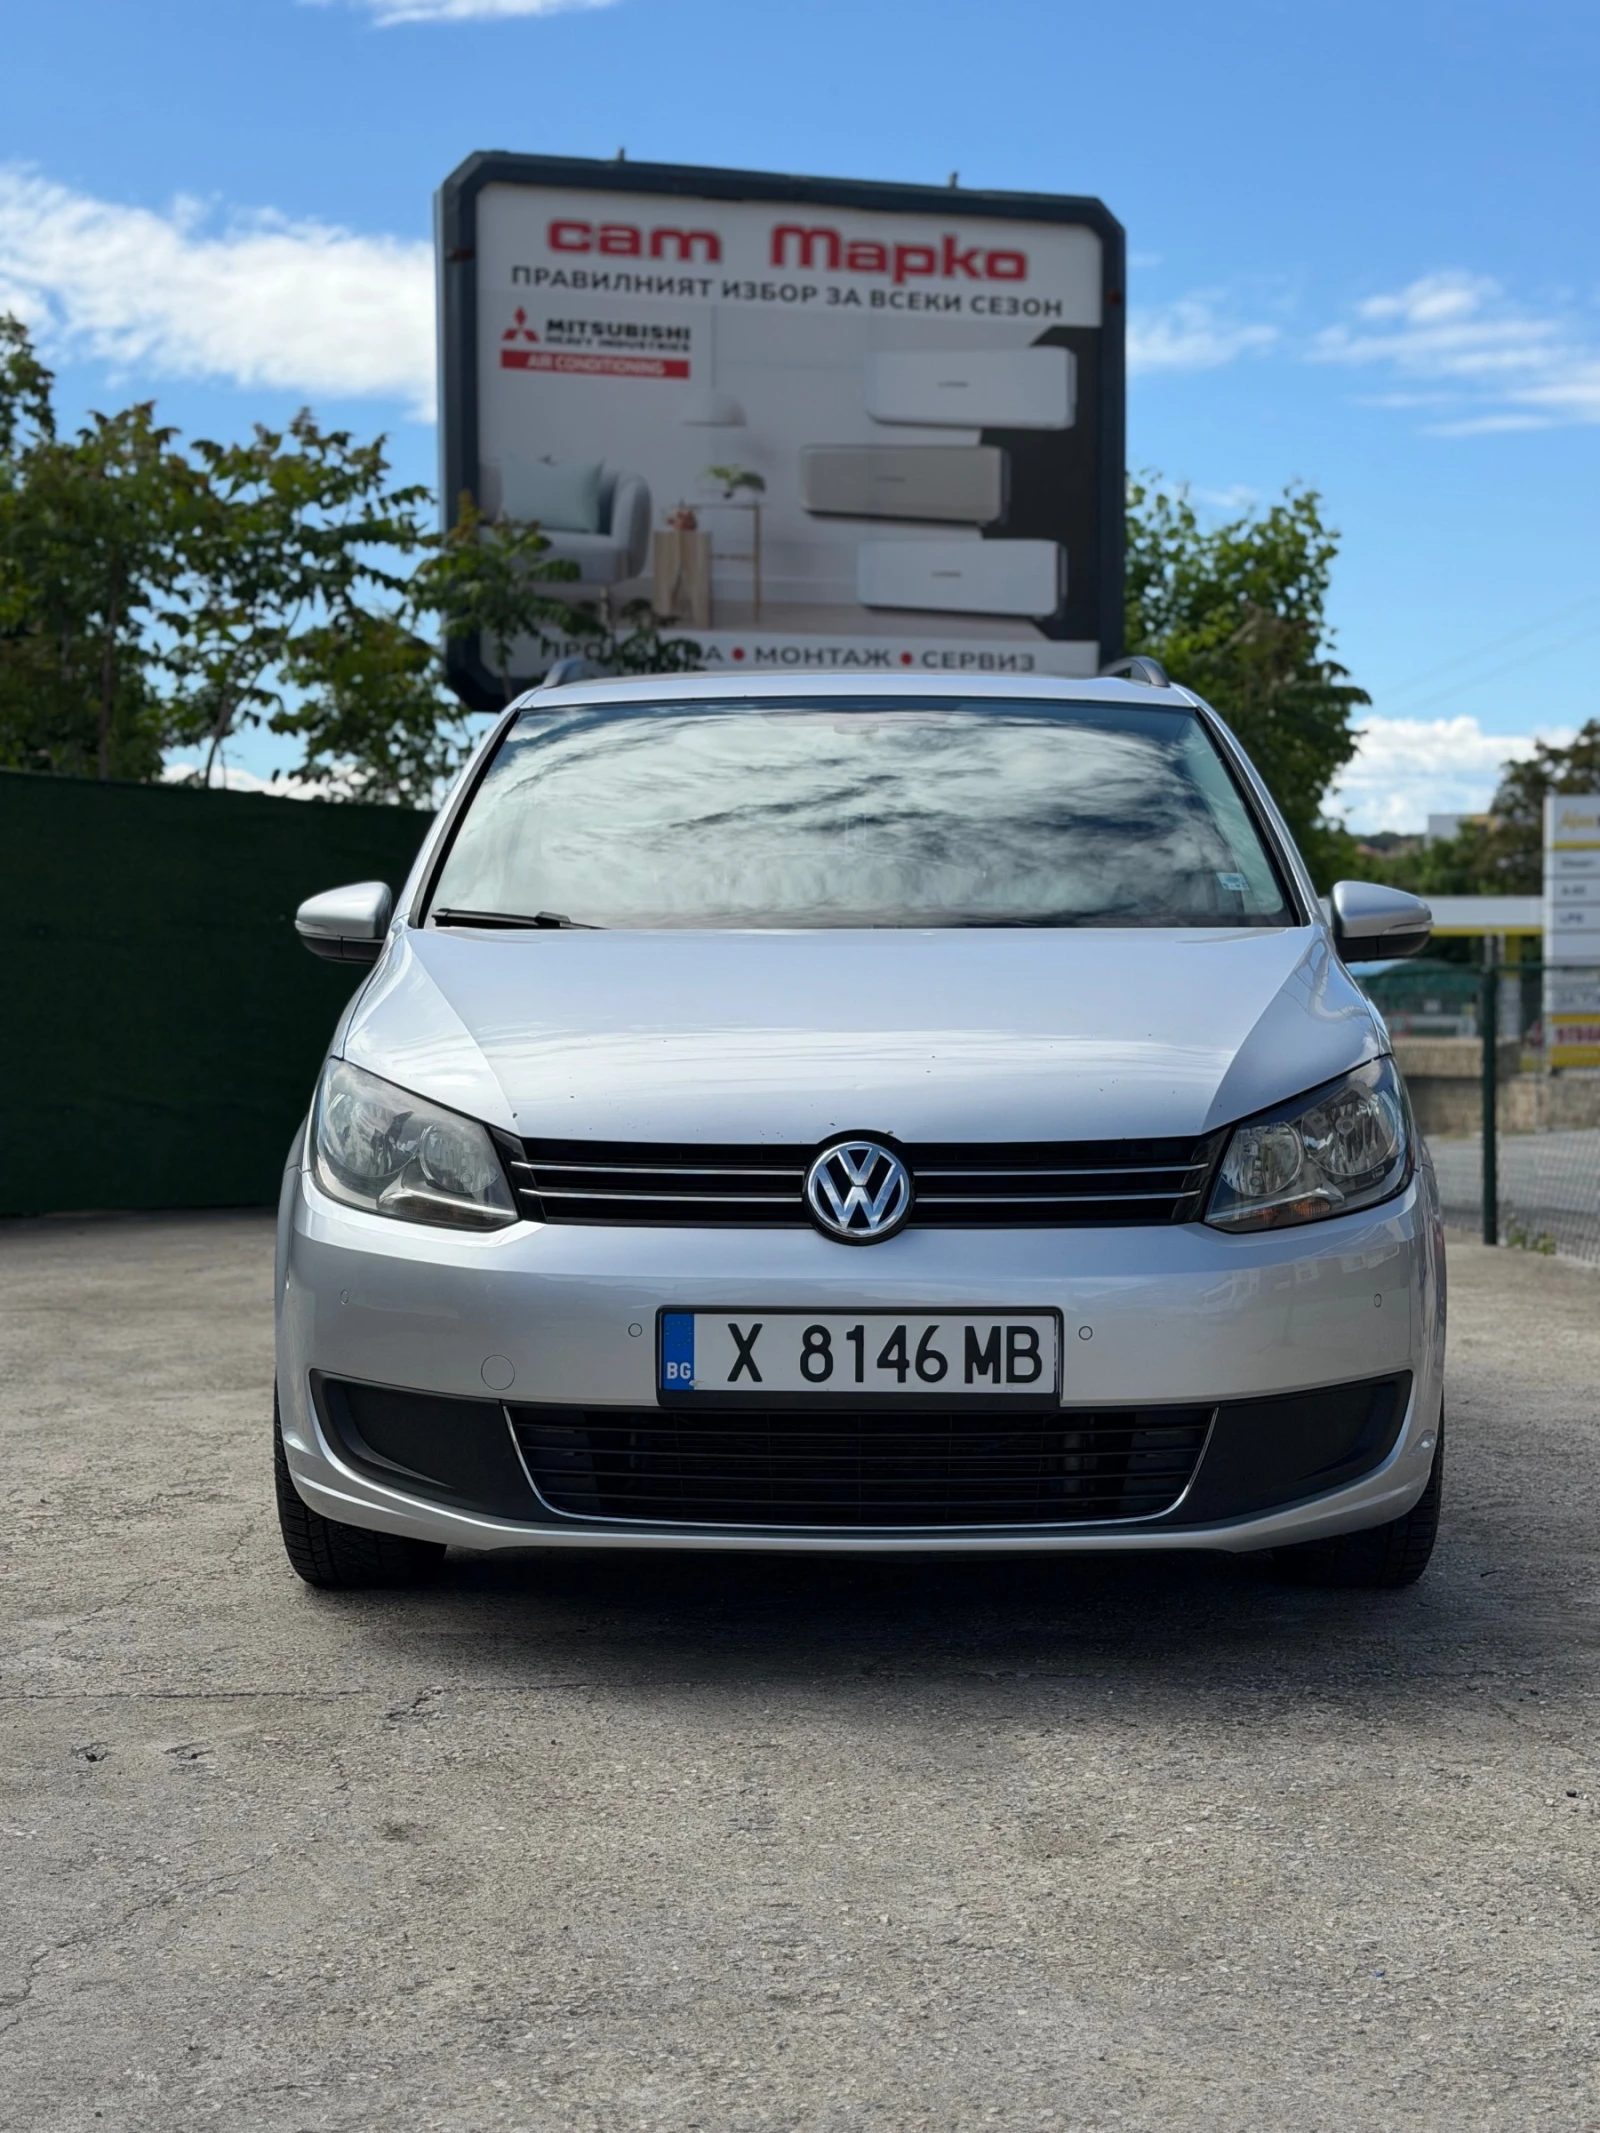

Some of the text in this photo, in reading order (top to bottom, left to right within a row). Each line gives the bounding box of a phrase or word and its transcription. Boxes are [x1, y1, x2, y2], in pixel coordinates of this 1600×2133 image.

[511, 265, 1063, 318] ПРАВИЛНИЯТ ИЗБОР ЗА ВСЕКИ СЕЗОН
[546, 318, 692, 341] MITSUBISHI
[754, 645, 891, 667] МОНТАЖ
[921, 650, 1035, 672] СЕРВИЗ
[727, 1323, 1042, 1384] X 8146 MB
[666, 1361, 691, 1379] BG
